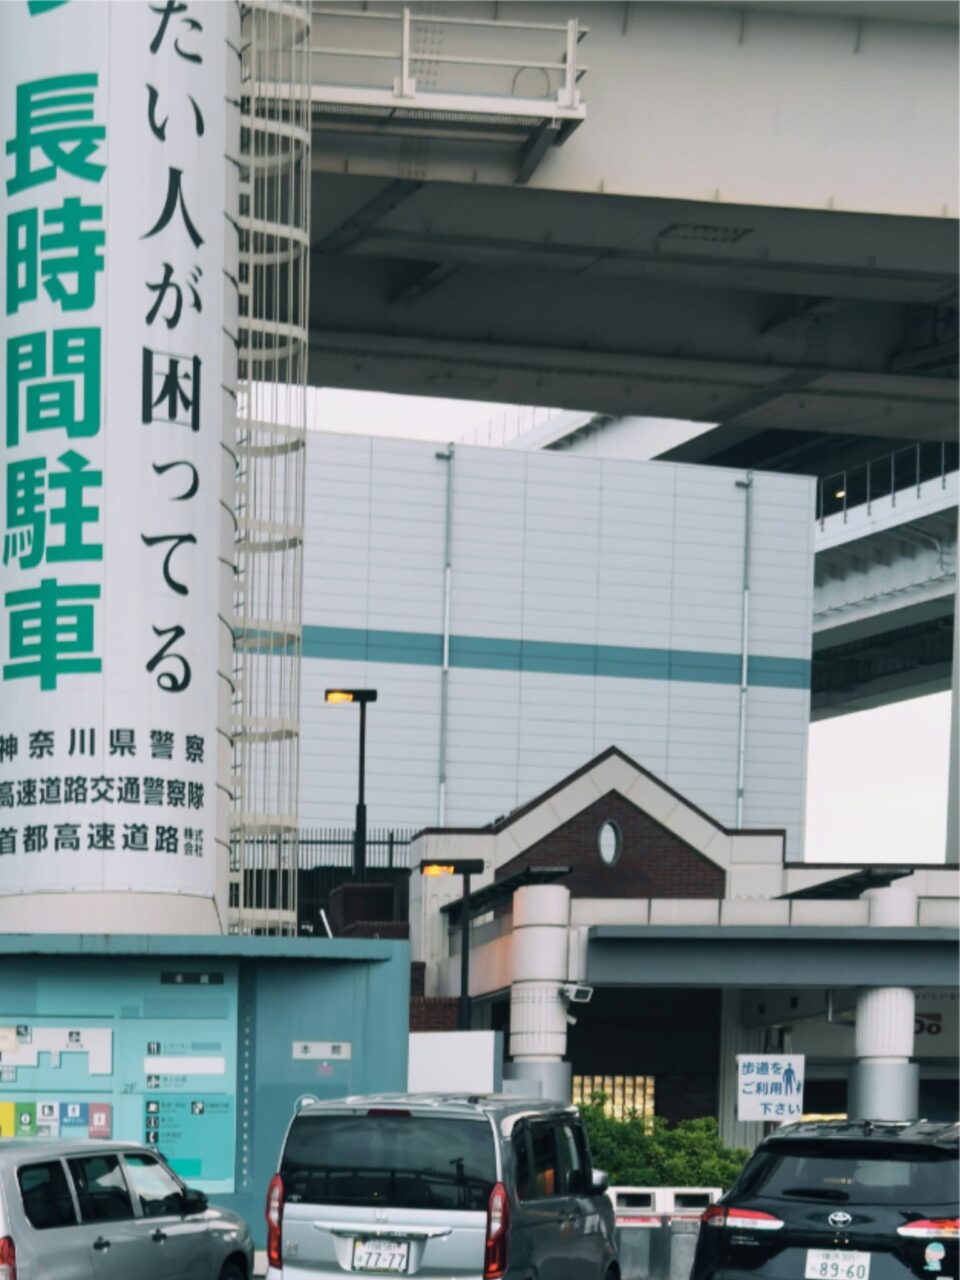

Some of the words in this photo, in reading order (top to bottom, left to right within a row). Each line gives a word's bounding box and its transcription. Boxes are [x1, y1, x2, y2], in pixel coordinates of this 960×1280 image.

[2, 72, 106, 692] 長時間駐車
[742, 1061, 783, 1076] 歩道を
[742, 1081, 782, 1096] ご利用
[759, 1102, 801, 1116] 下さい
